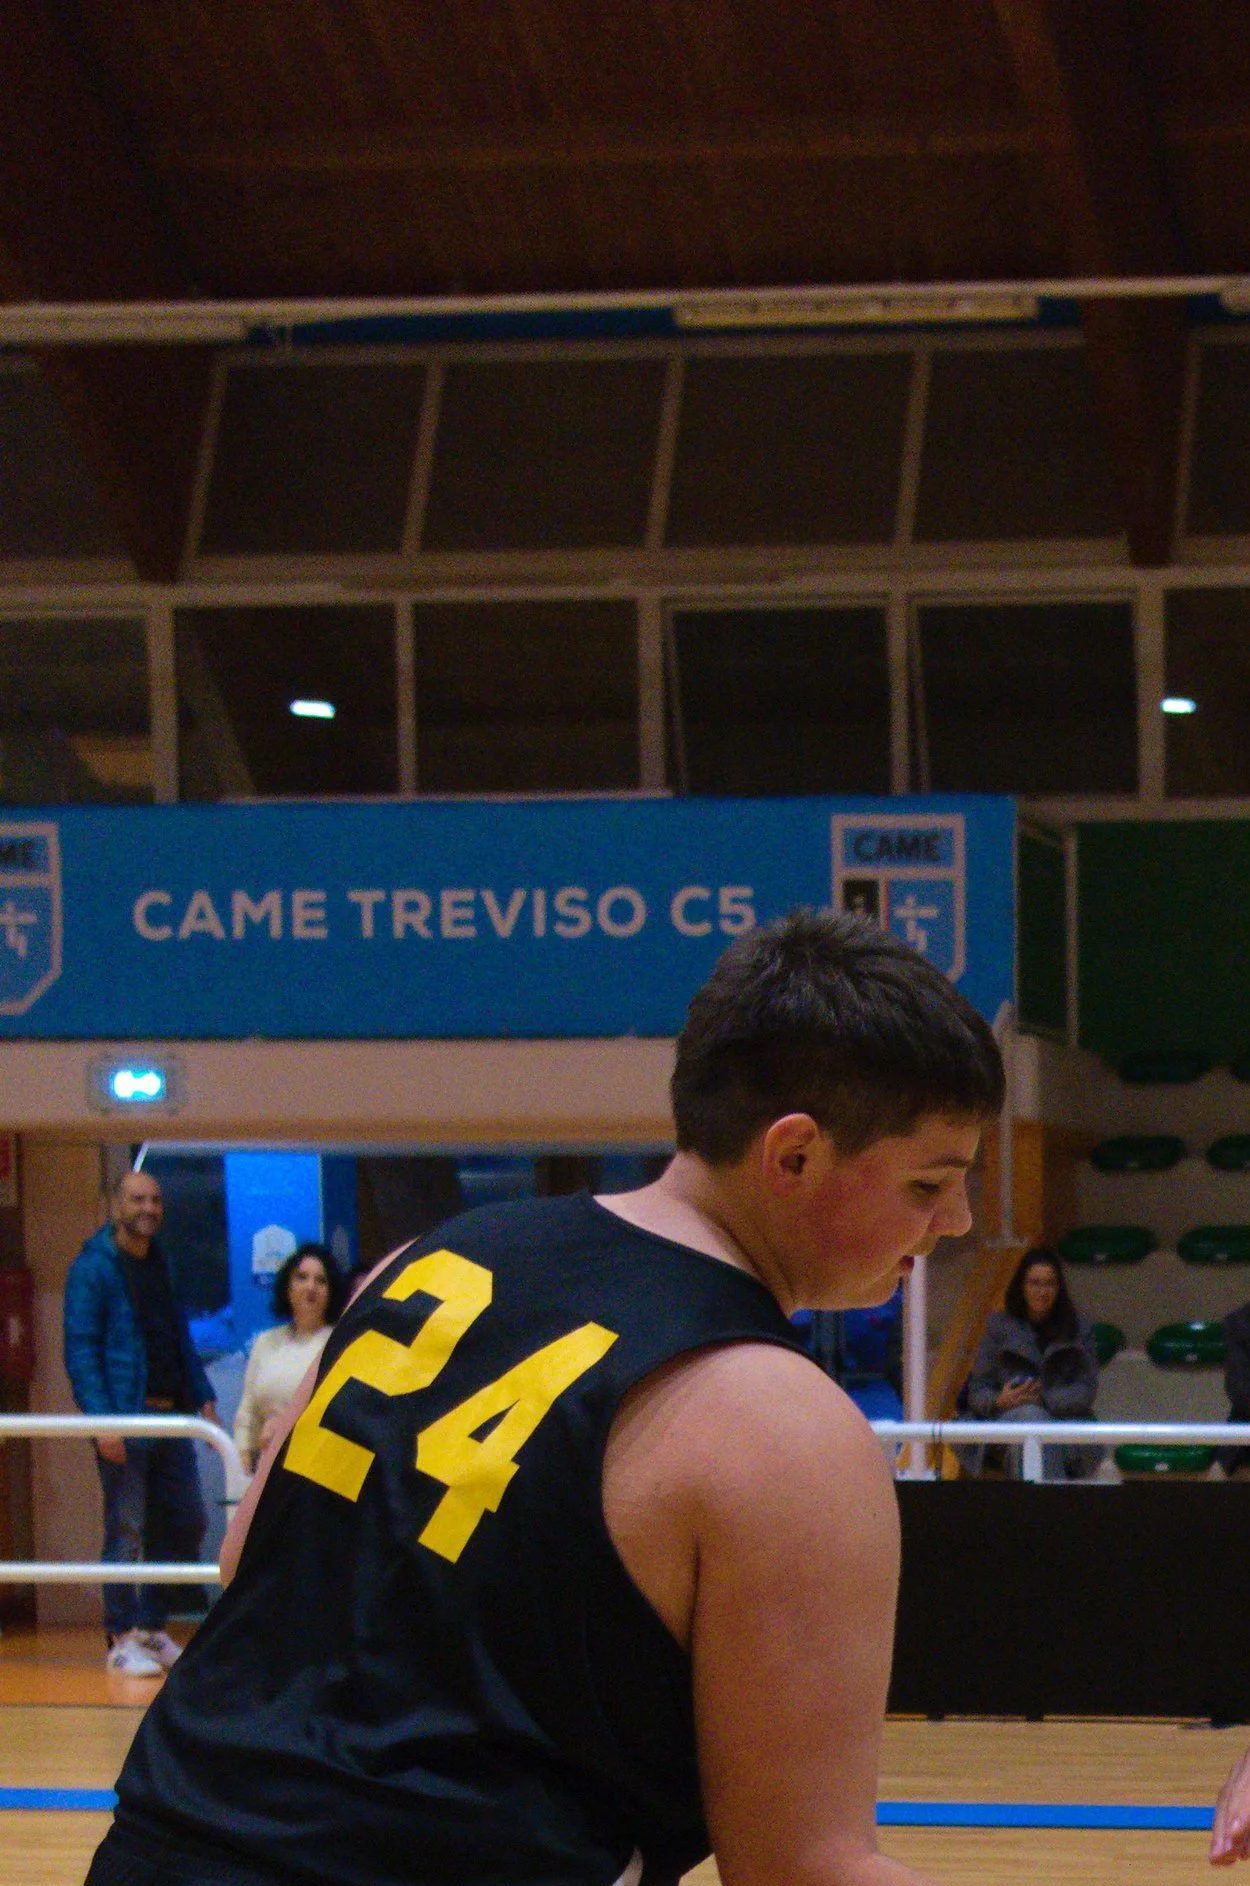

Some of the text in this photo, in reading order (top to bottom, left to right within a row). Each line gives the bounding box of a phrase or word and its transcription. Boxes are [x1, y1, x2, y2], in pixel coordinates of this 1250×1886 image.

[853, 832, 942, 861] CAME
[132, 885, 757, 941] CAME TREVISO C5
[282, 1248, 620, 1565] 24
